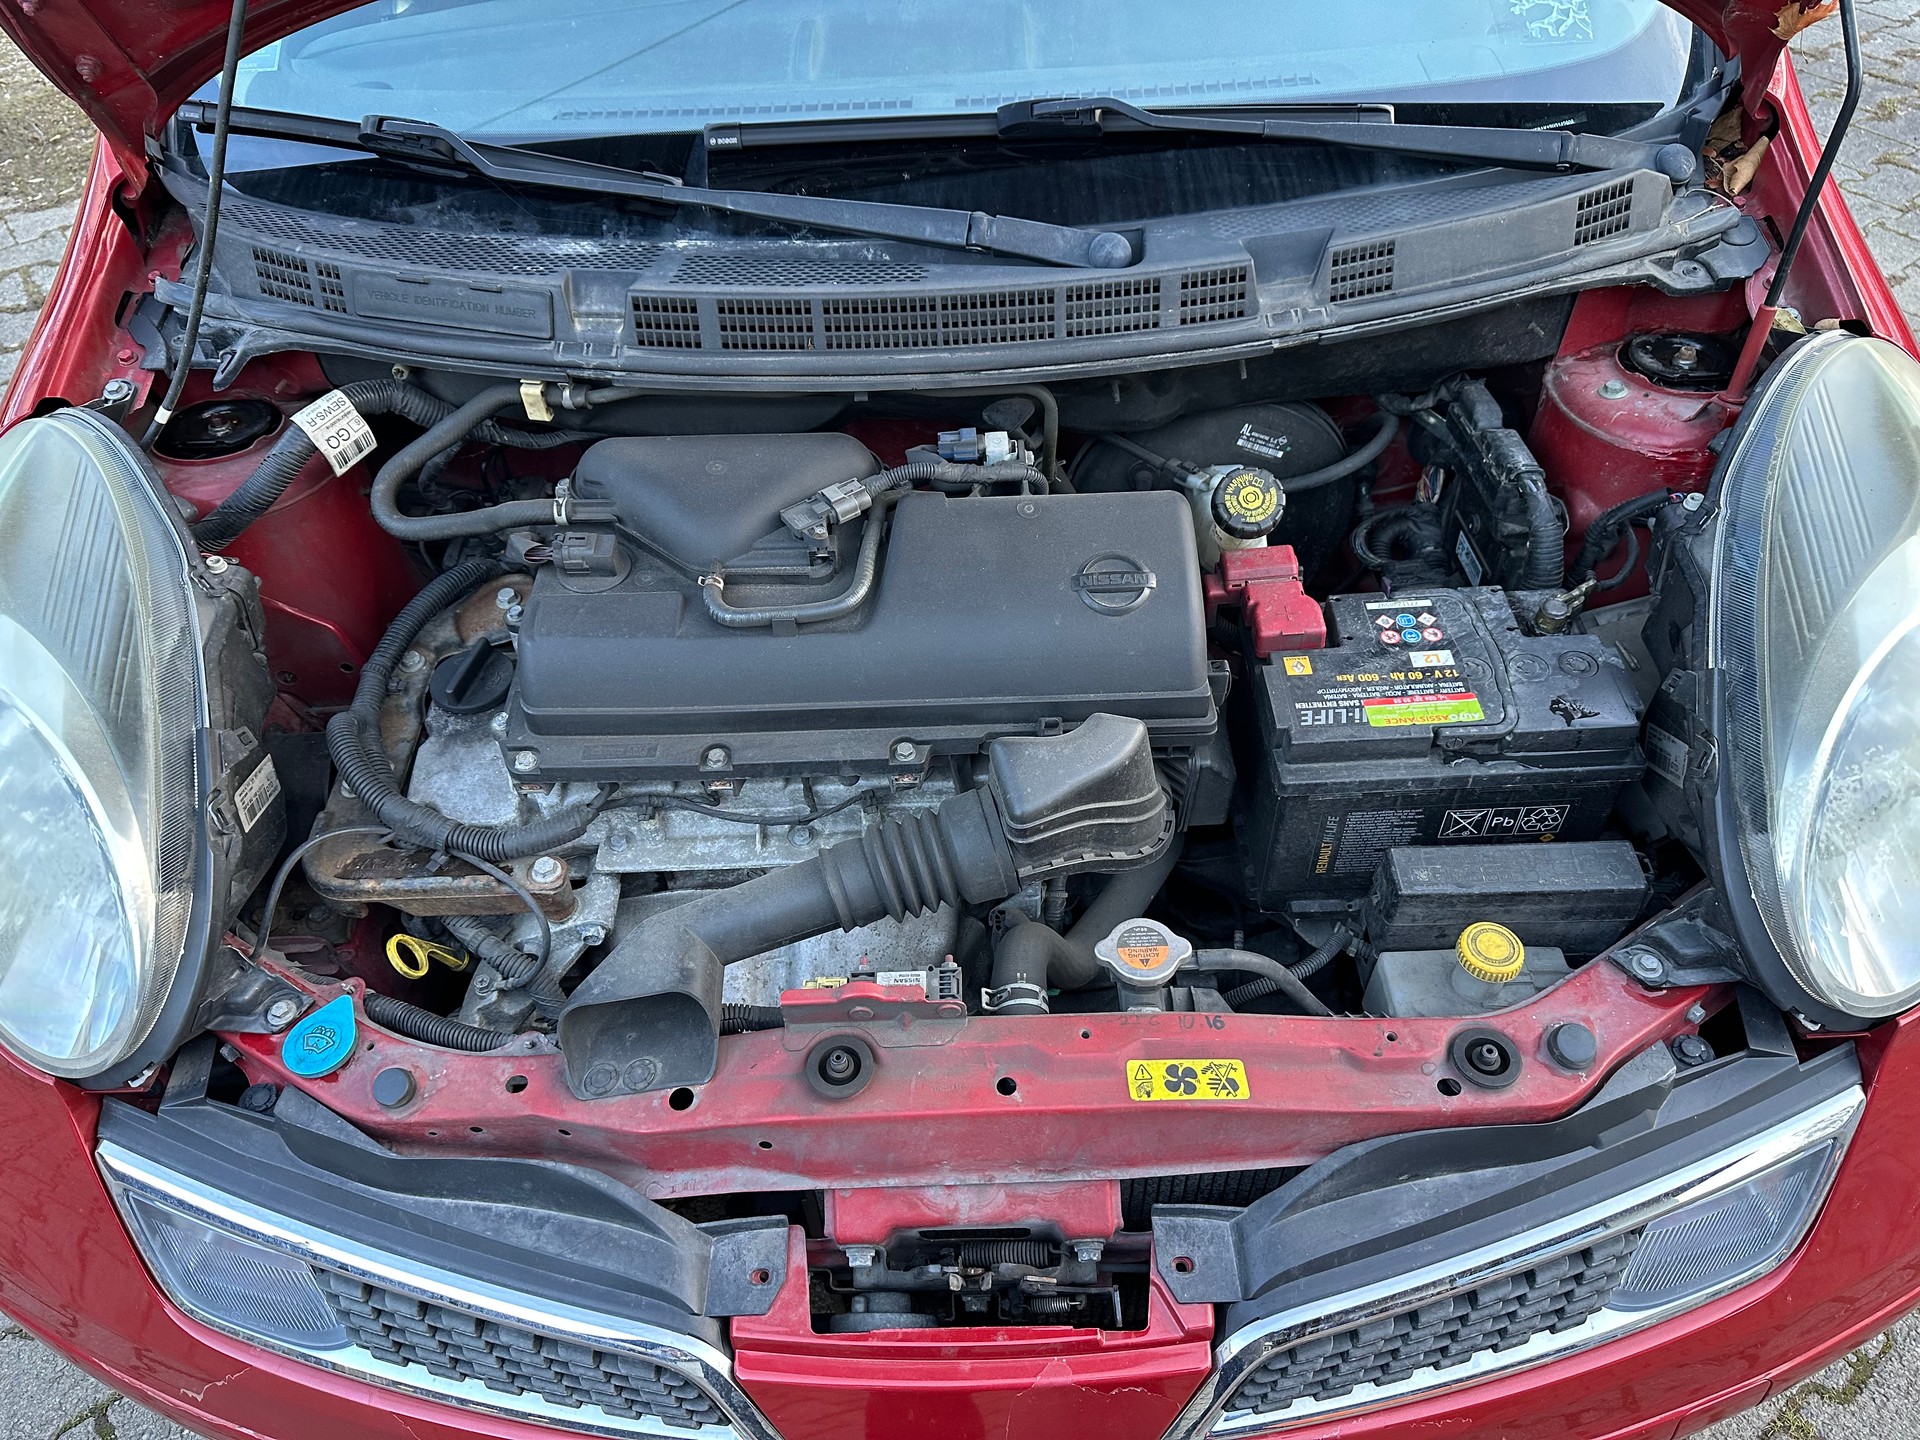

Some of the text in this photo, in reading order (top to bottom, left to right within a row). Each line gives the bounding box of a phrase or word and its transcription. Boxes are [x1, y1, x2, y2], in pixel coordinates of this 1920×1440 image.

[367, 289, 536, 318] VEHICLE IDENTIFICATION NUMBER
[306, 396, 347, 427] SEWS-R
[1240, 423, 1252, 436] AL
[325, 428, 351, 449] GQ
[1226, 473, 1254, 493] WARNING
[1079, 573, 1147, 587] NISSAN
[1423, 653, 1441, 663] L2
[1358, 673, 1379, 682] 600
[1390, 671, 1405, 680] Ah
[1408, 671, 1423, 680] 60
[1434, 670, 1443, 679] V
[1444, 669, 1459, 678] 12
[1295, 700, 1360, 709] SANS ENTRETIEN
[1491, 816, 1514, 827] Pb
[1205, 1015, 1226, 1031] 16
